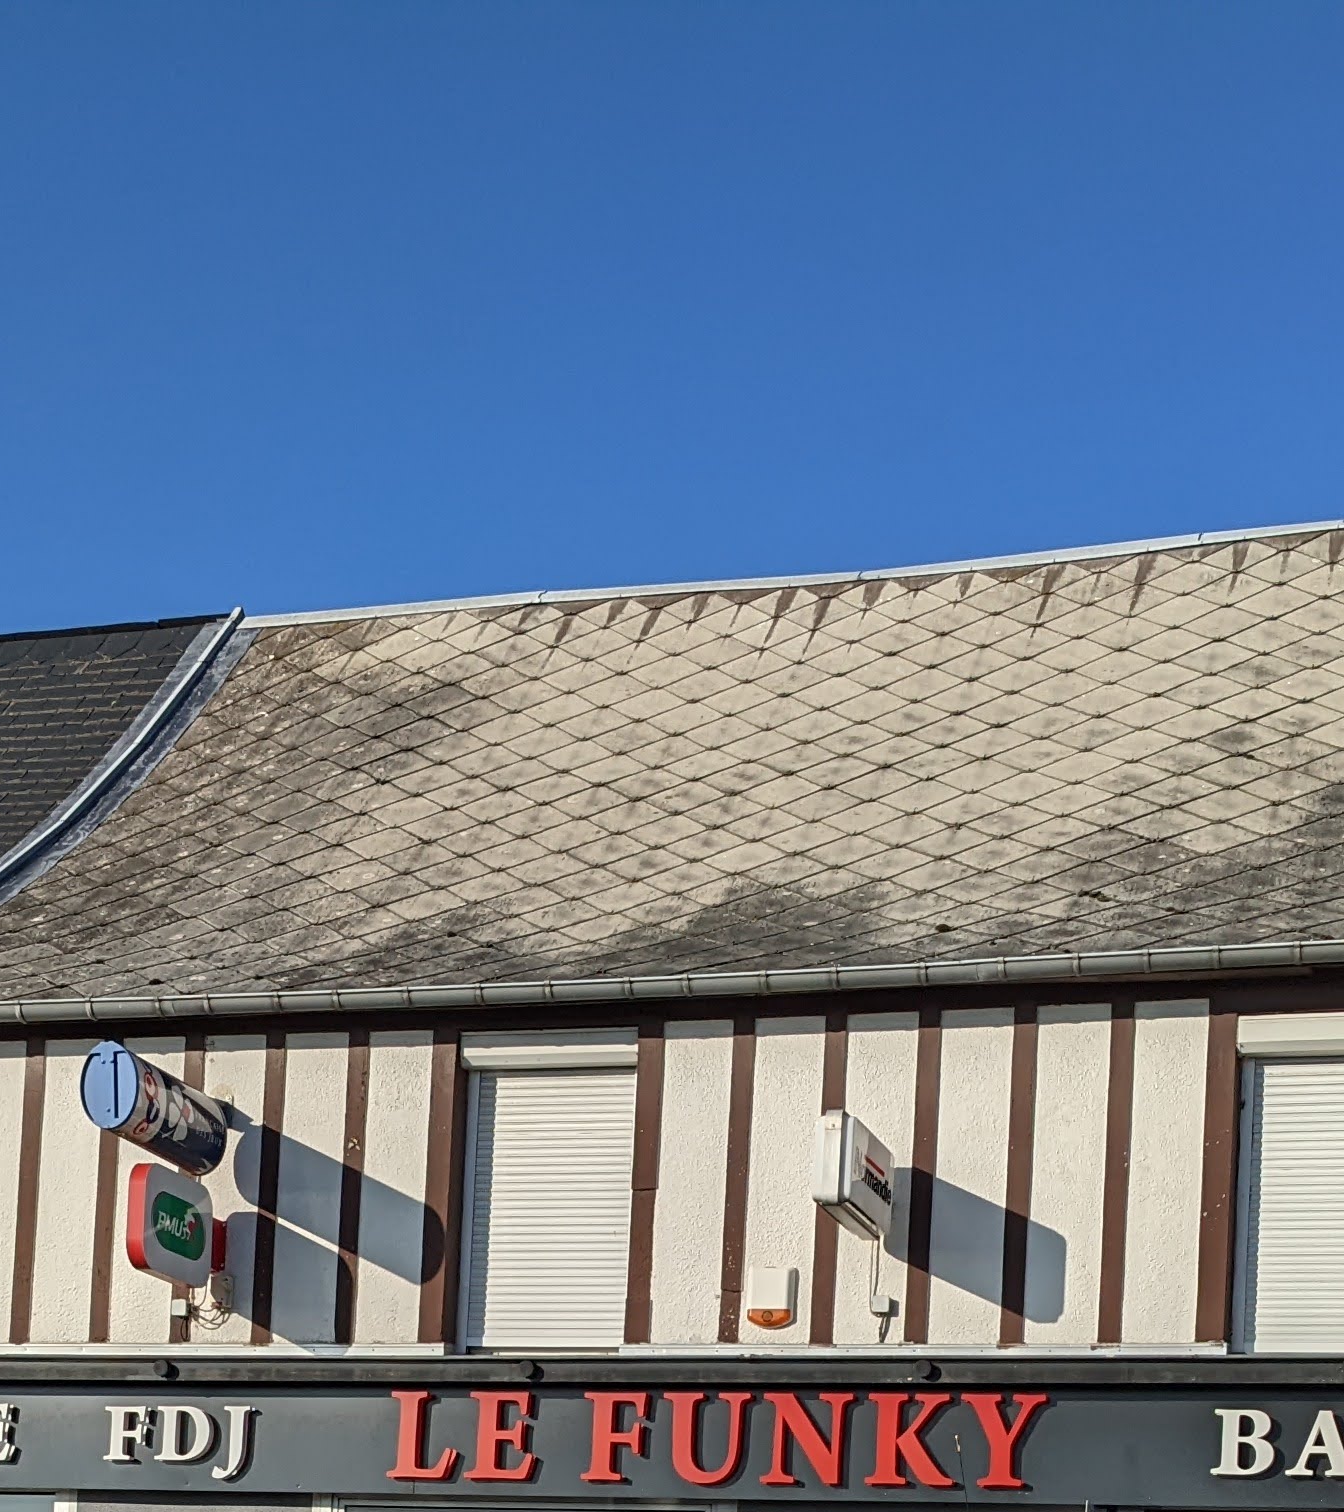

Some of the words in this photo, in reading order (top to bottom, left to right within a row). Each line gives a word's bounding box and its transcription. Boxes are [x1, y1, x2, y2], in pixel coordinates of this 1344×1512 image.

[158, 1211, 184, 1239] PMU
[103, 1404, 255, 1480] FDJ
[385, 1390, 536, 1482] LE
[580, 1390, 1048, 1489] FUNKY
